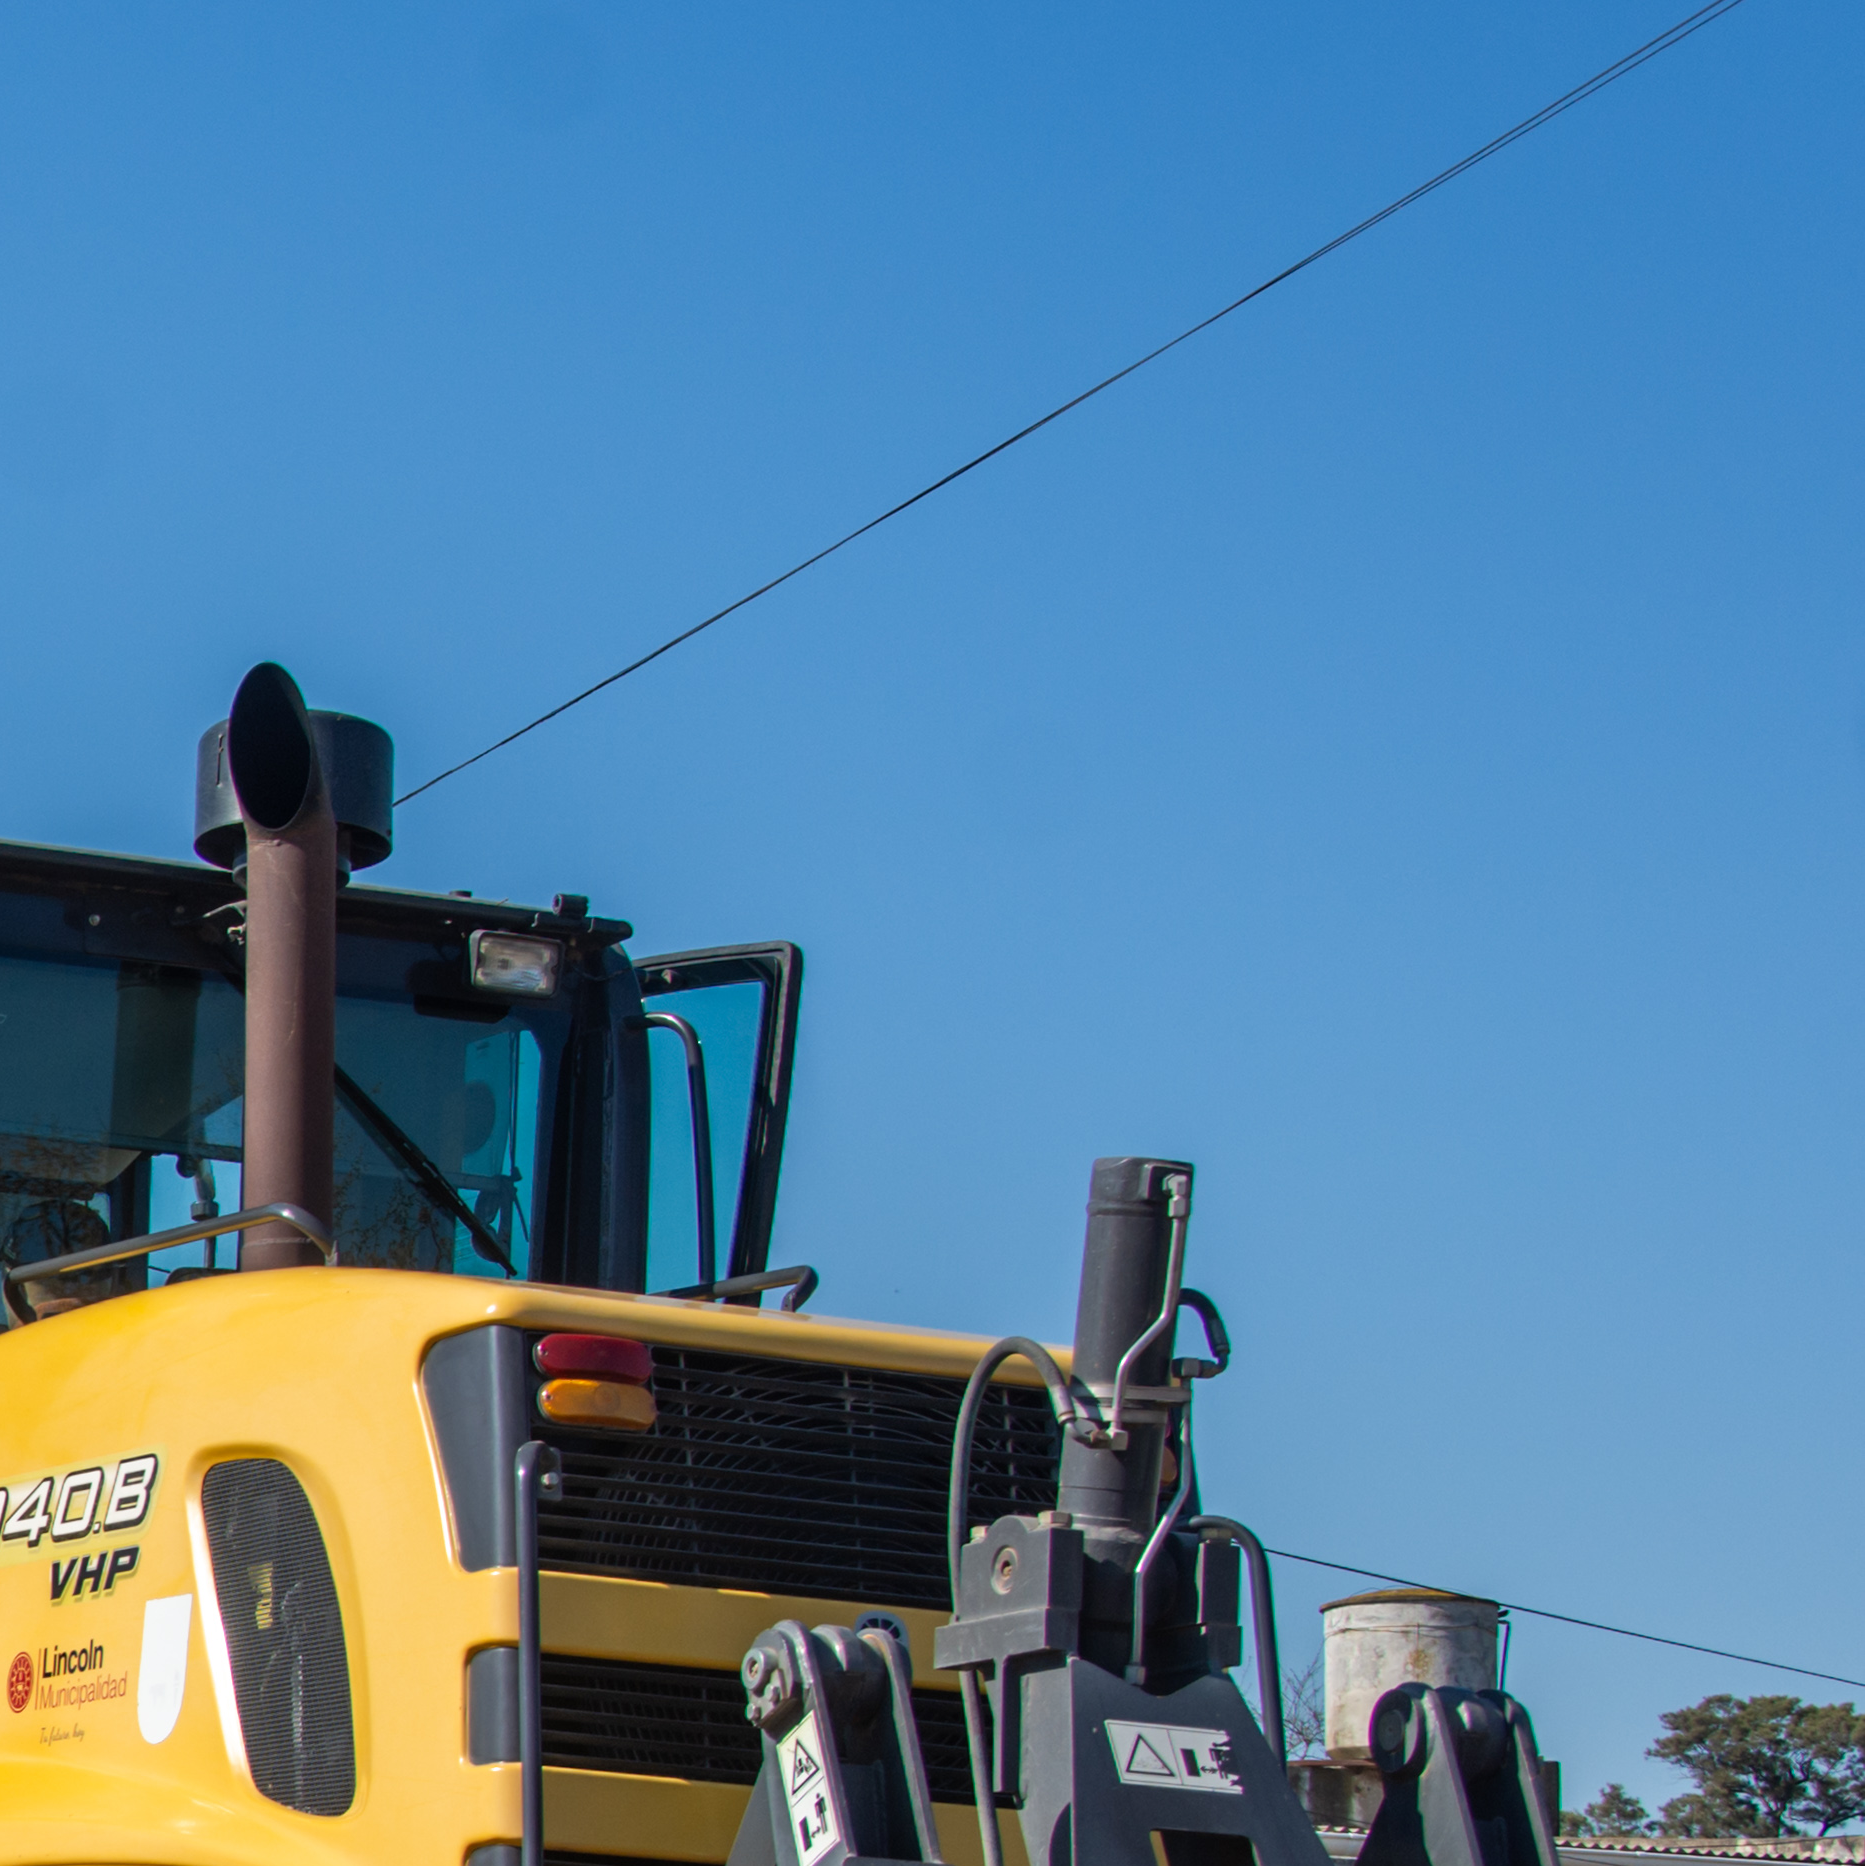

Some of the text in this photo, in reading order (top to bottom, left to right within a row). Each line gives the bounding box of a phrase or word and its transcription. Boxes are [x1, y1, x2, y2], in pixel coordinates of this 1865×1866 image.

[50, 1544, 140, 1600] VHP
[42, 1638, 104, 1679] Lincoln
[39, 1670, 128, 1711] Municipalidad
